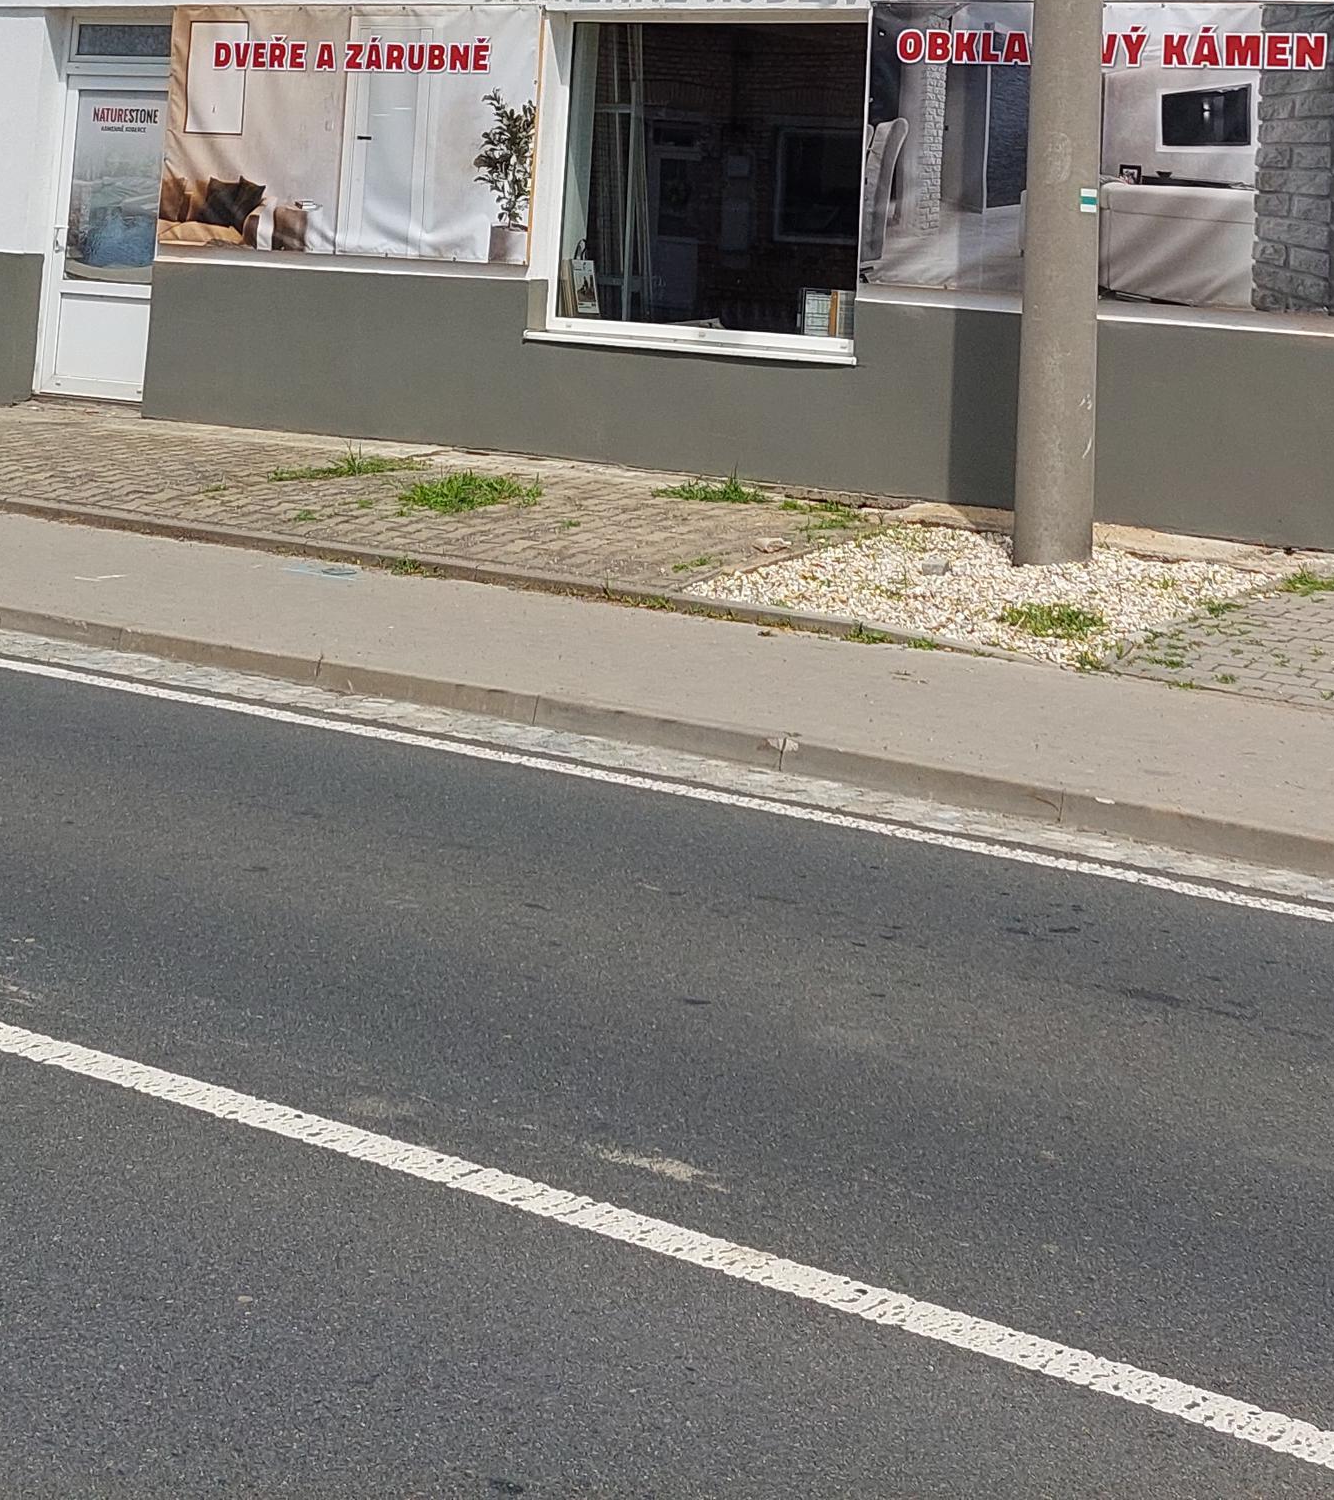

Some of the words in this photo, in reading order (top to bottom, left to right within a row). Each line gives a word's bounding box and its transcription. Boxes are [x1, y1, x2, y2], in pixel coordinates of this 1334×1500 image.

[214, 35, 306, 70] DVEŘE
[315, 41, 335, 70] A
[344, 35, 492, 72] ZÁRUBNĚ
[897, 25, 1148, 67] OBKLAVÝ
[1162, 26, 1327, 69] KÁMEN
[92, 106, 160, 124] NATURESTONE
